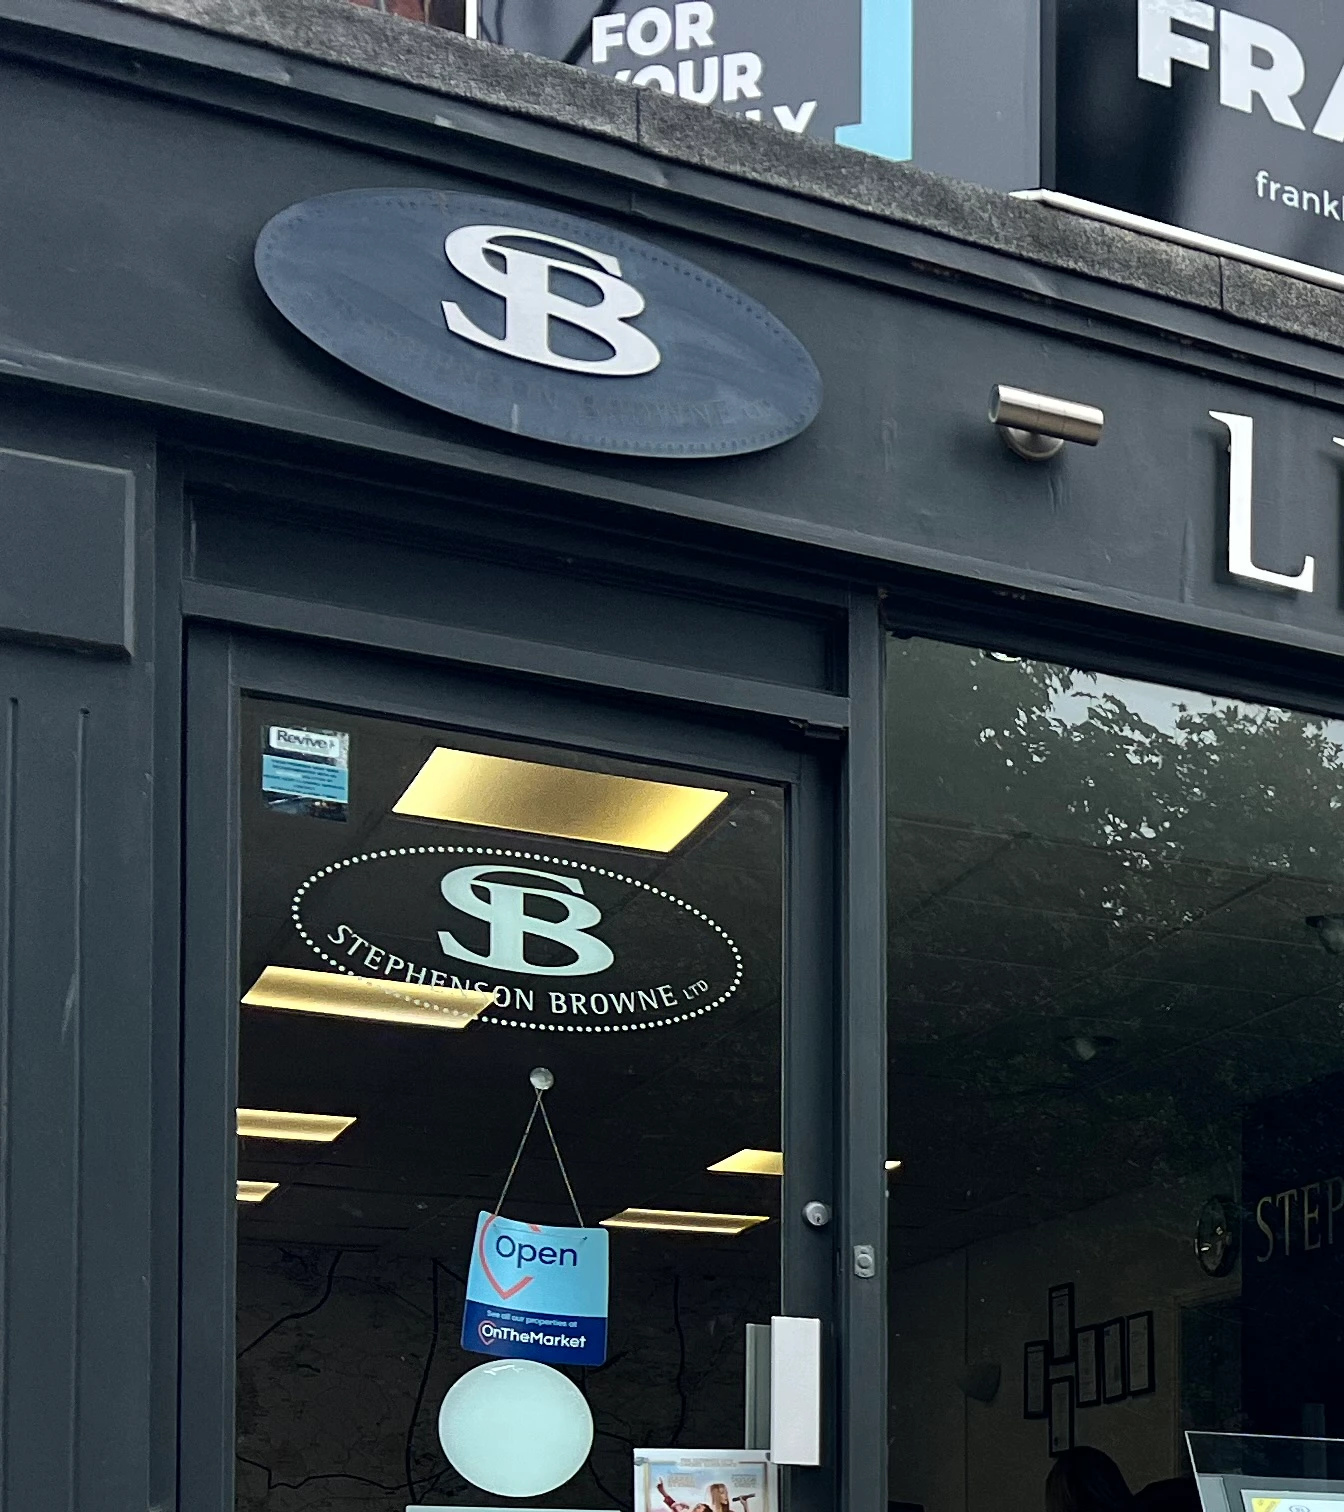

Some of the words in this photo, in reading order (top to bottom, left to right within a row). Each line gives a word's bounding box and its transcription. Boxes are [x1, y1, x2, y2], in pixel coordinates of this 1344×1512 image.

[592, 1, 715, 63] FOR
[614, 51, 762, 107] OUR
[326, 922, 534, 1011] STEPHENSON
[550, 984, 678, 1017] BROWNE
[683, 978, 710, 1002] LTD
[495, 1235, 578, 1270] Open
[482, 1323, 587, 1348] OnTheMarket
